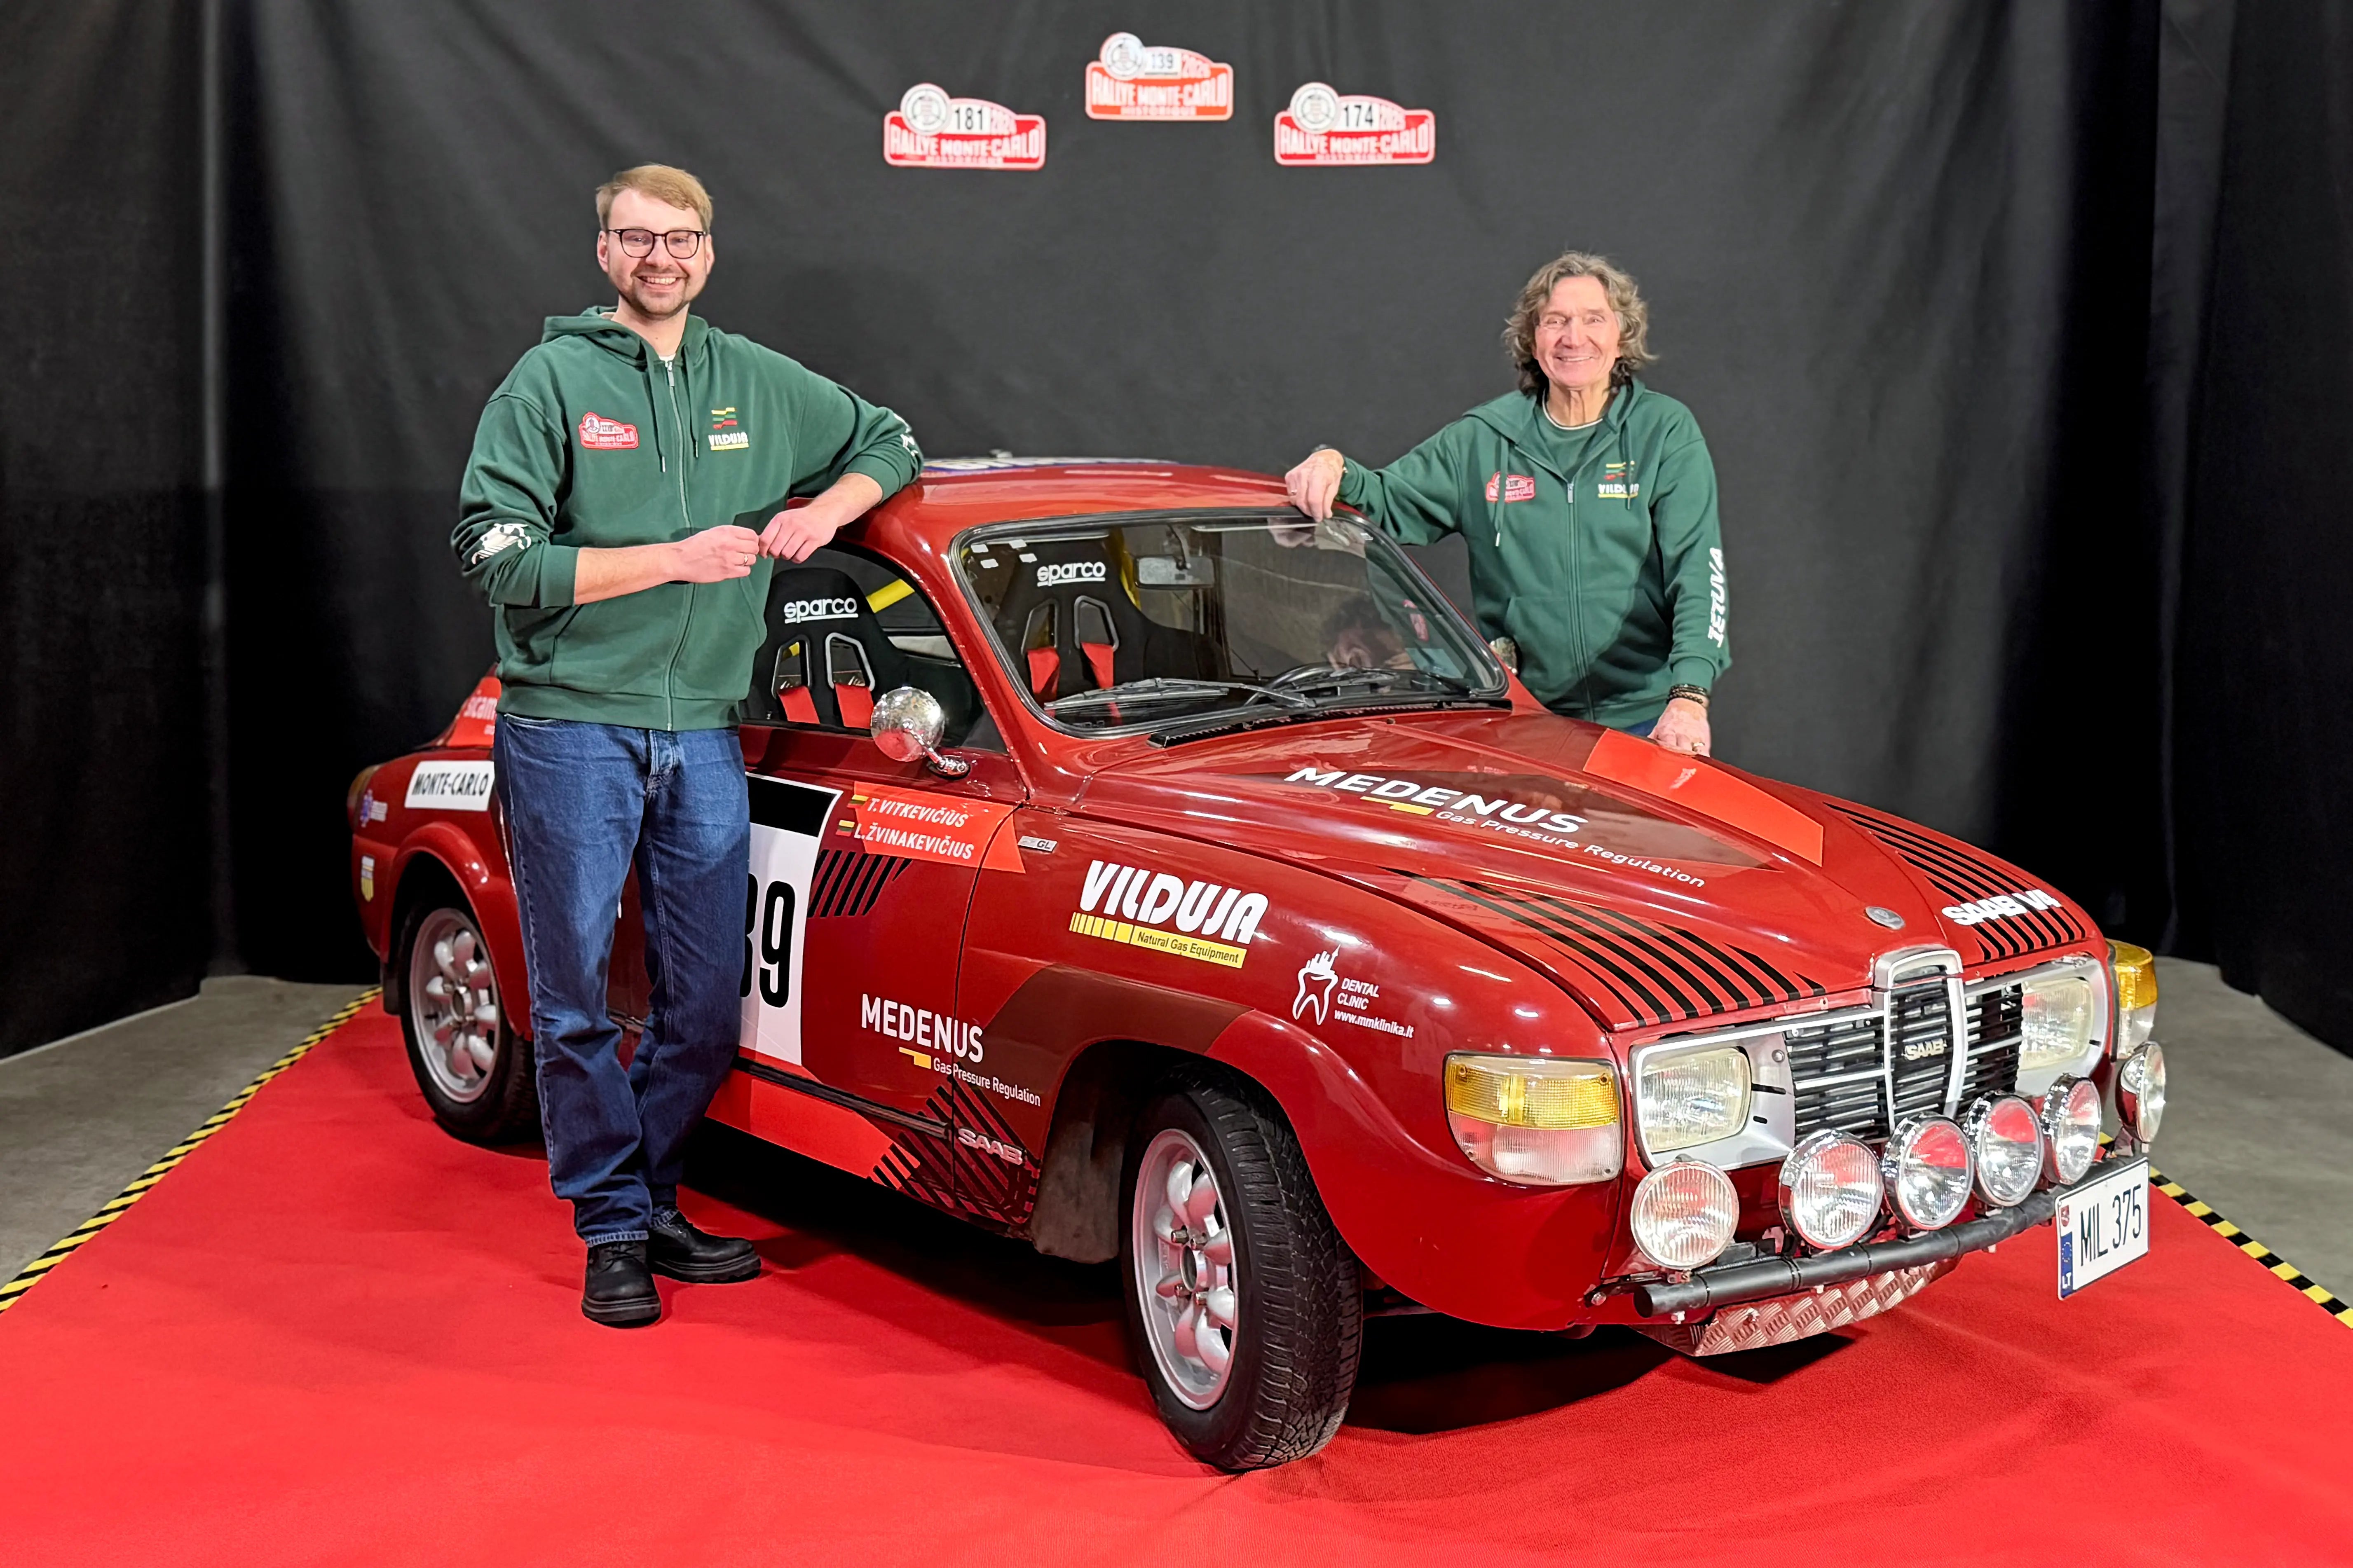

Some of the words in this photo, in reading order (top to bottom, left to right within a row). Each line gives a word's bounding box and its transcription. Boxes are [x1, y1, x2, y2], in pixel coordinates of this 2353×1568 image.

[1151, 54, 1173, 69] 139
[1092, 71, 1135, 106] RALLYE
[1137, 73, 1227, 106] MONTE-CARLO
[955, 107, 984, 130] 181
[1343, 105, 1373, 127] 174
[890, 124, 938, 155] RALLYE
[940, 127, 1040, 157] MONTE-CARLO
[1280, 125, 1327, 154] RALLYE
[1330, 123, 1429, 153] MONTE-CARLO
[708, 432, 748, 446] VILDUJA
[1037, 562, 1105, 586] sparco
[784, 598, 858, 623] sparco
[413, 773, 489, 796] MONTE-CARLO
[867, 797, 969, 828] T.VITKEVIČIUS
[1284, 768, 1589, 833] MEDENUS
[854, 822, 975, 860] L.ŽVINAKEVIČIUS
[1037, 840, 1050, 849] GL
[1436, 811, 1476, 825] Gas
[1480, 820, 1580, 850] Pressure
[1584, 845, 1705, 887] Regulation
[1079, 860, 1269, 945] VILDUJA
[1941, 895, 2028, 925] SAAB
[1137, 931, 1169, 949] Natural
[1171, 938, 1188, 953] Gas
[1190, 943, 1239, 963] Equipment
[1337, 992, 1369, 1010] CLINIC
[1341, 978, 1379, 998] DENTAL
[861, 993, 984, 1063] MEDENUS
[1334, 1010, 1415, 1039] www.mmklinika.lt
[1905, 1038, 1945, 1061] SAAB
[933, 1058, 952, 1075] Gas
[953, 1063, 990, 1089] Pressure
[993, 1077, 1041, 1107] Regulation
[957, 1128, 1022, 1165] SAAB
[2081, 1203, 2108, 1267] MIL
[2112, 1184, 2141, 1249] 375
[2062, 1272, 2072, 1289] LT
